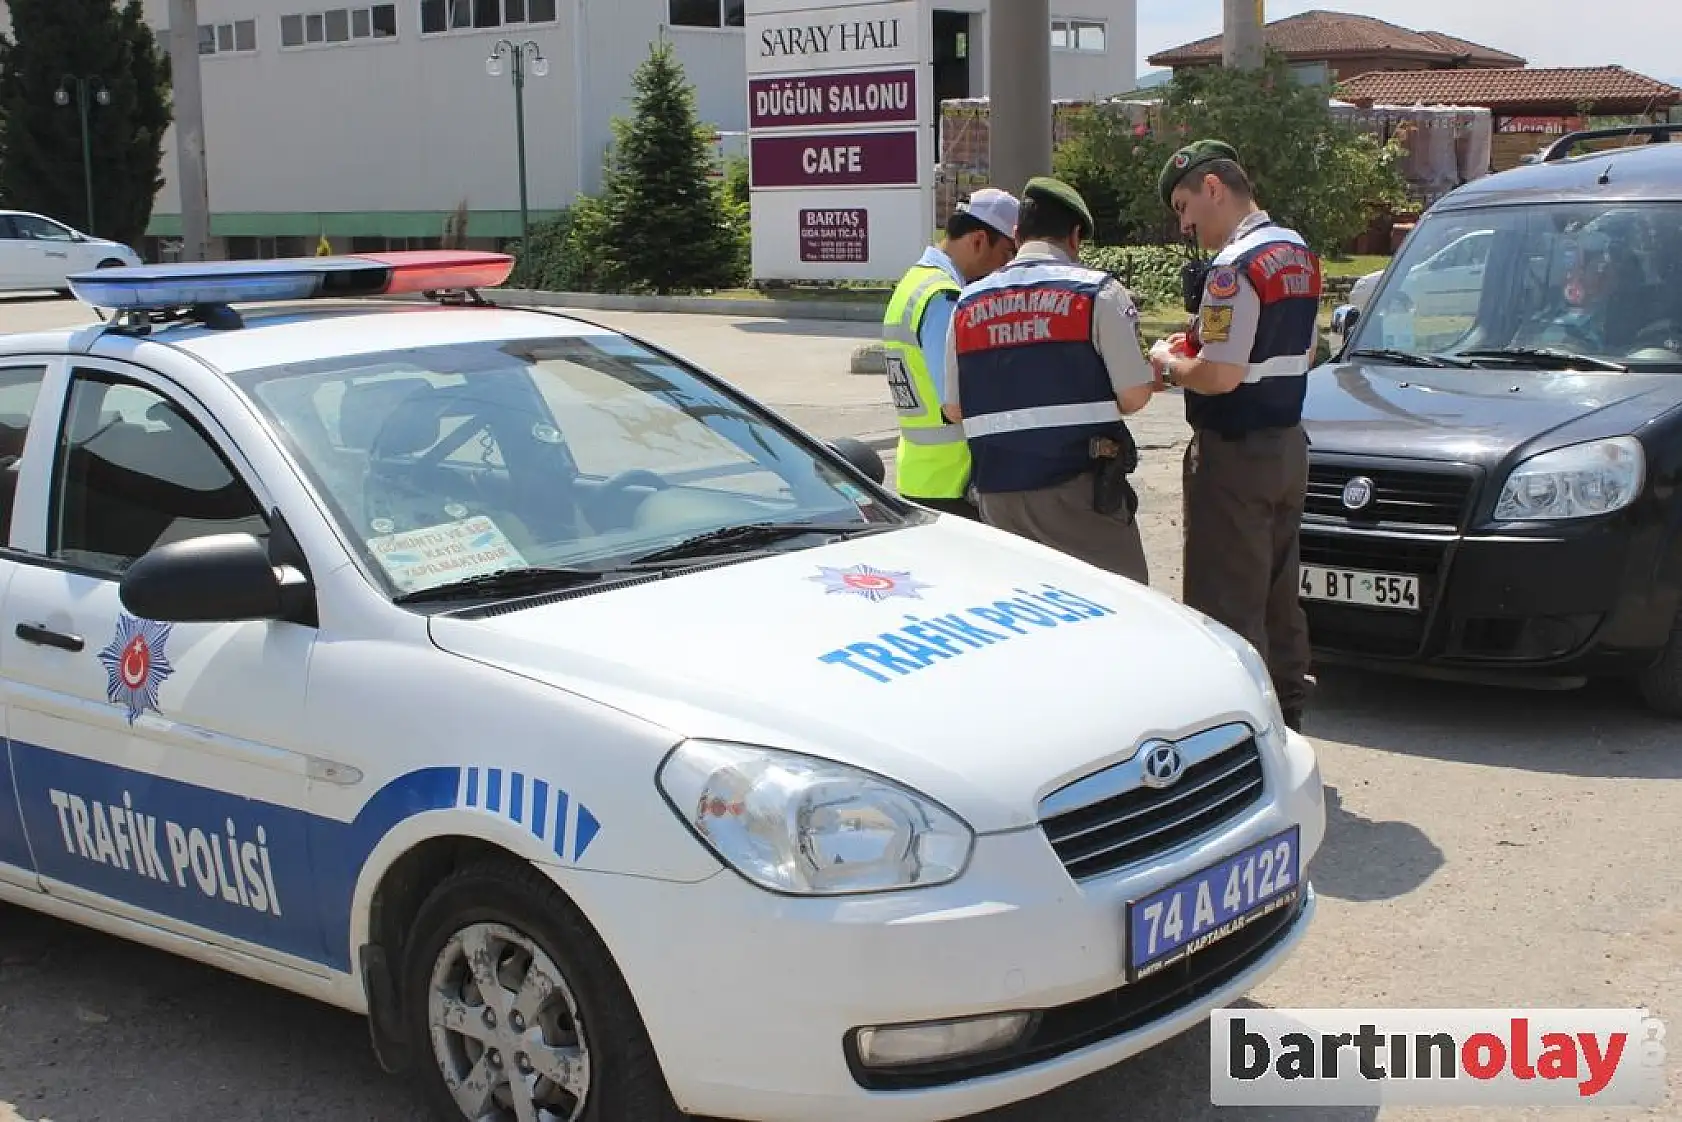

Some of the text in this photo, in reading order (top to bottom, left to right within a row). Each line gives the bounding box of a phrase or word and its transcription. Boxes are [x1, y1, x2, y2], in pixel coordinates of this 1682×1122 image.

[761, 19, 900, 57] SARAY HALI
[756, 81, 908, 116] DÜĞÜN SALONU
[802, 146, 862, 174] CAFE
[806, 211, 860, 228] BARTAŞ
[967, 290, 1072, 328] JANDARMA
[987, 315, 1051, 346] TRAFİK
[1300, 569, 1415, 607] 4 BT 554
[817, 582, 1118, 683] TRAFİK POLİSİ
[50, 789, 283, 918] TRAFİK POLİSİ
[1143, 840, 1292, 955] 74 A 4122
